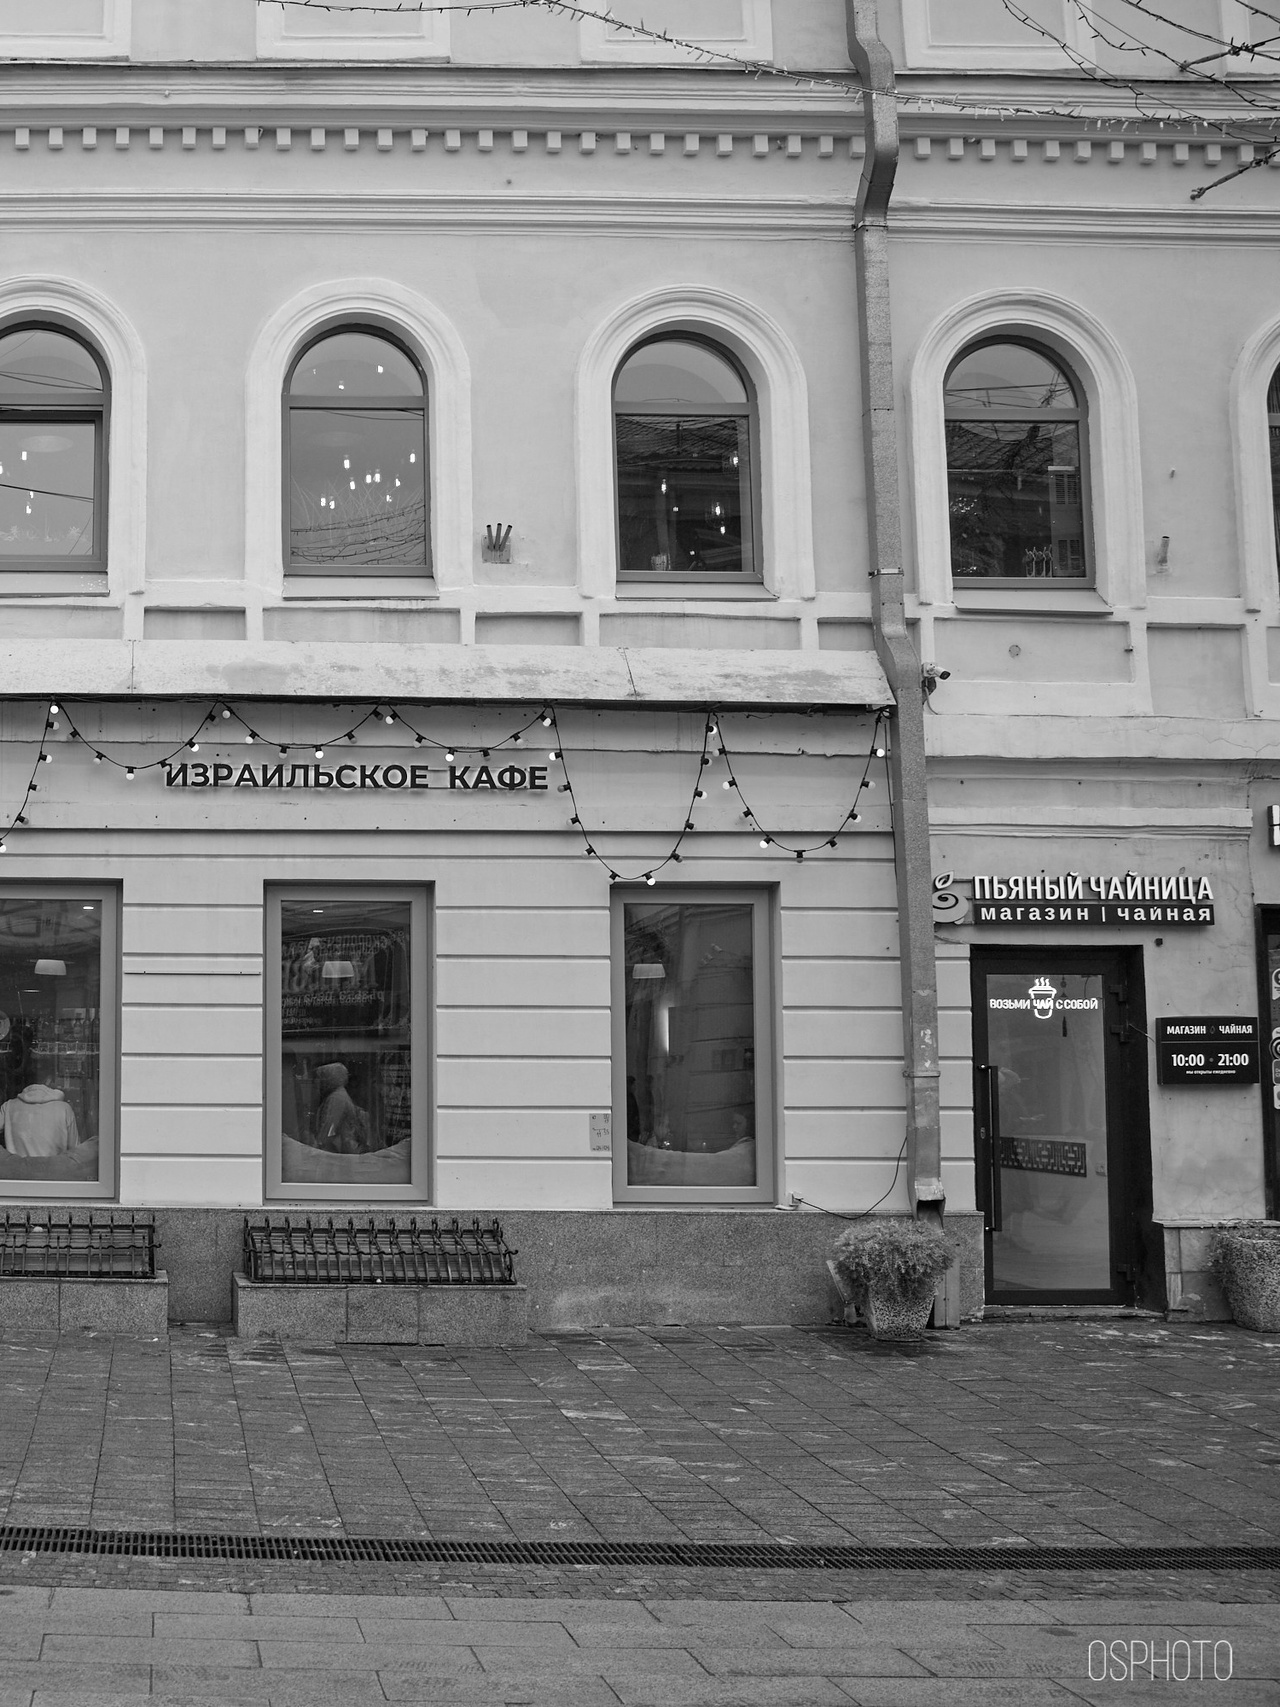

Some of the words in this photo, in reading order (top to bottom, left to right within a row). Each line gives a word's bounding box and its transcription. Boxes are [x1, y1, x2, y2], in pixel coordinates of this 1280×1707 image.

[166, 763, 429, 789] ИЗРАИЛЬСКОЕ
[448, 765, 549, 791] КАФЕ
[974, 872, 1083, 899] ПЬЯНЫЙ
[1089, 872, 1214, 904] ЧАЙНИЦА
[981, 907, 1089, 921] магазин
[1117, 906, 1211, 921] чайная
[989, 999, 1031, 1010] ВОЗЬМИ
[1032, 998, 1054, 1010] ЧАЙ
[1166, 1025, 1207, 1034] МАГАЗИН
[1219, 1024, 1253, 1034] ЧАЙНАЯ
[1171, 1054, 1205, 1067] 10:00
[1217, 1053, 1250, 1066] 21:00
